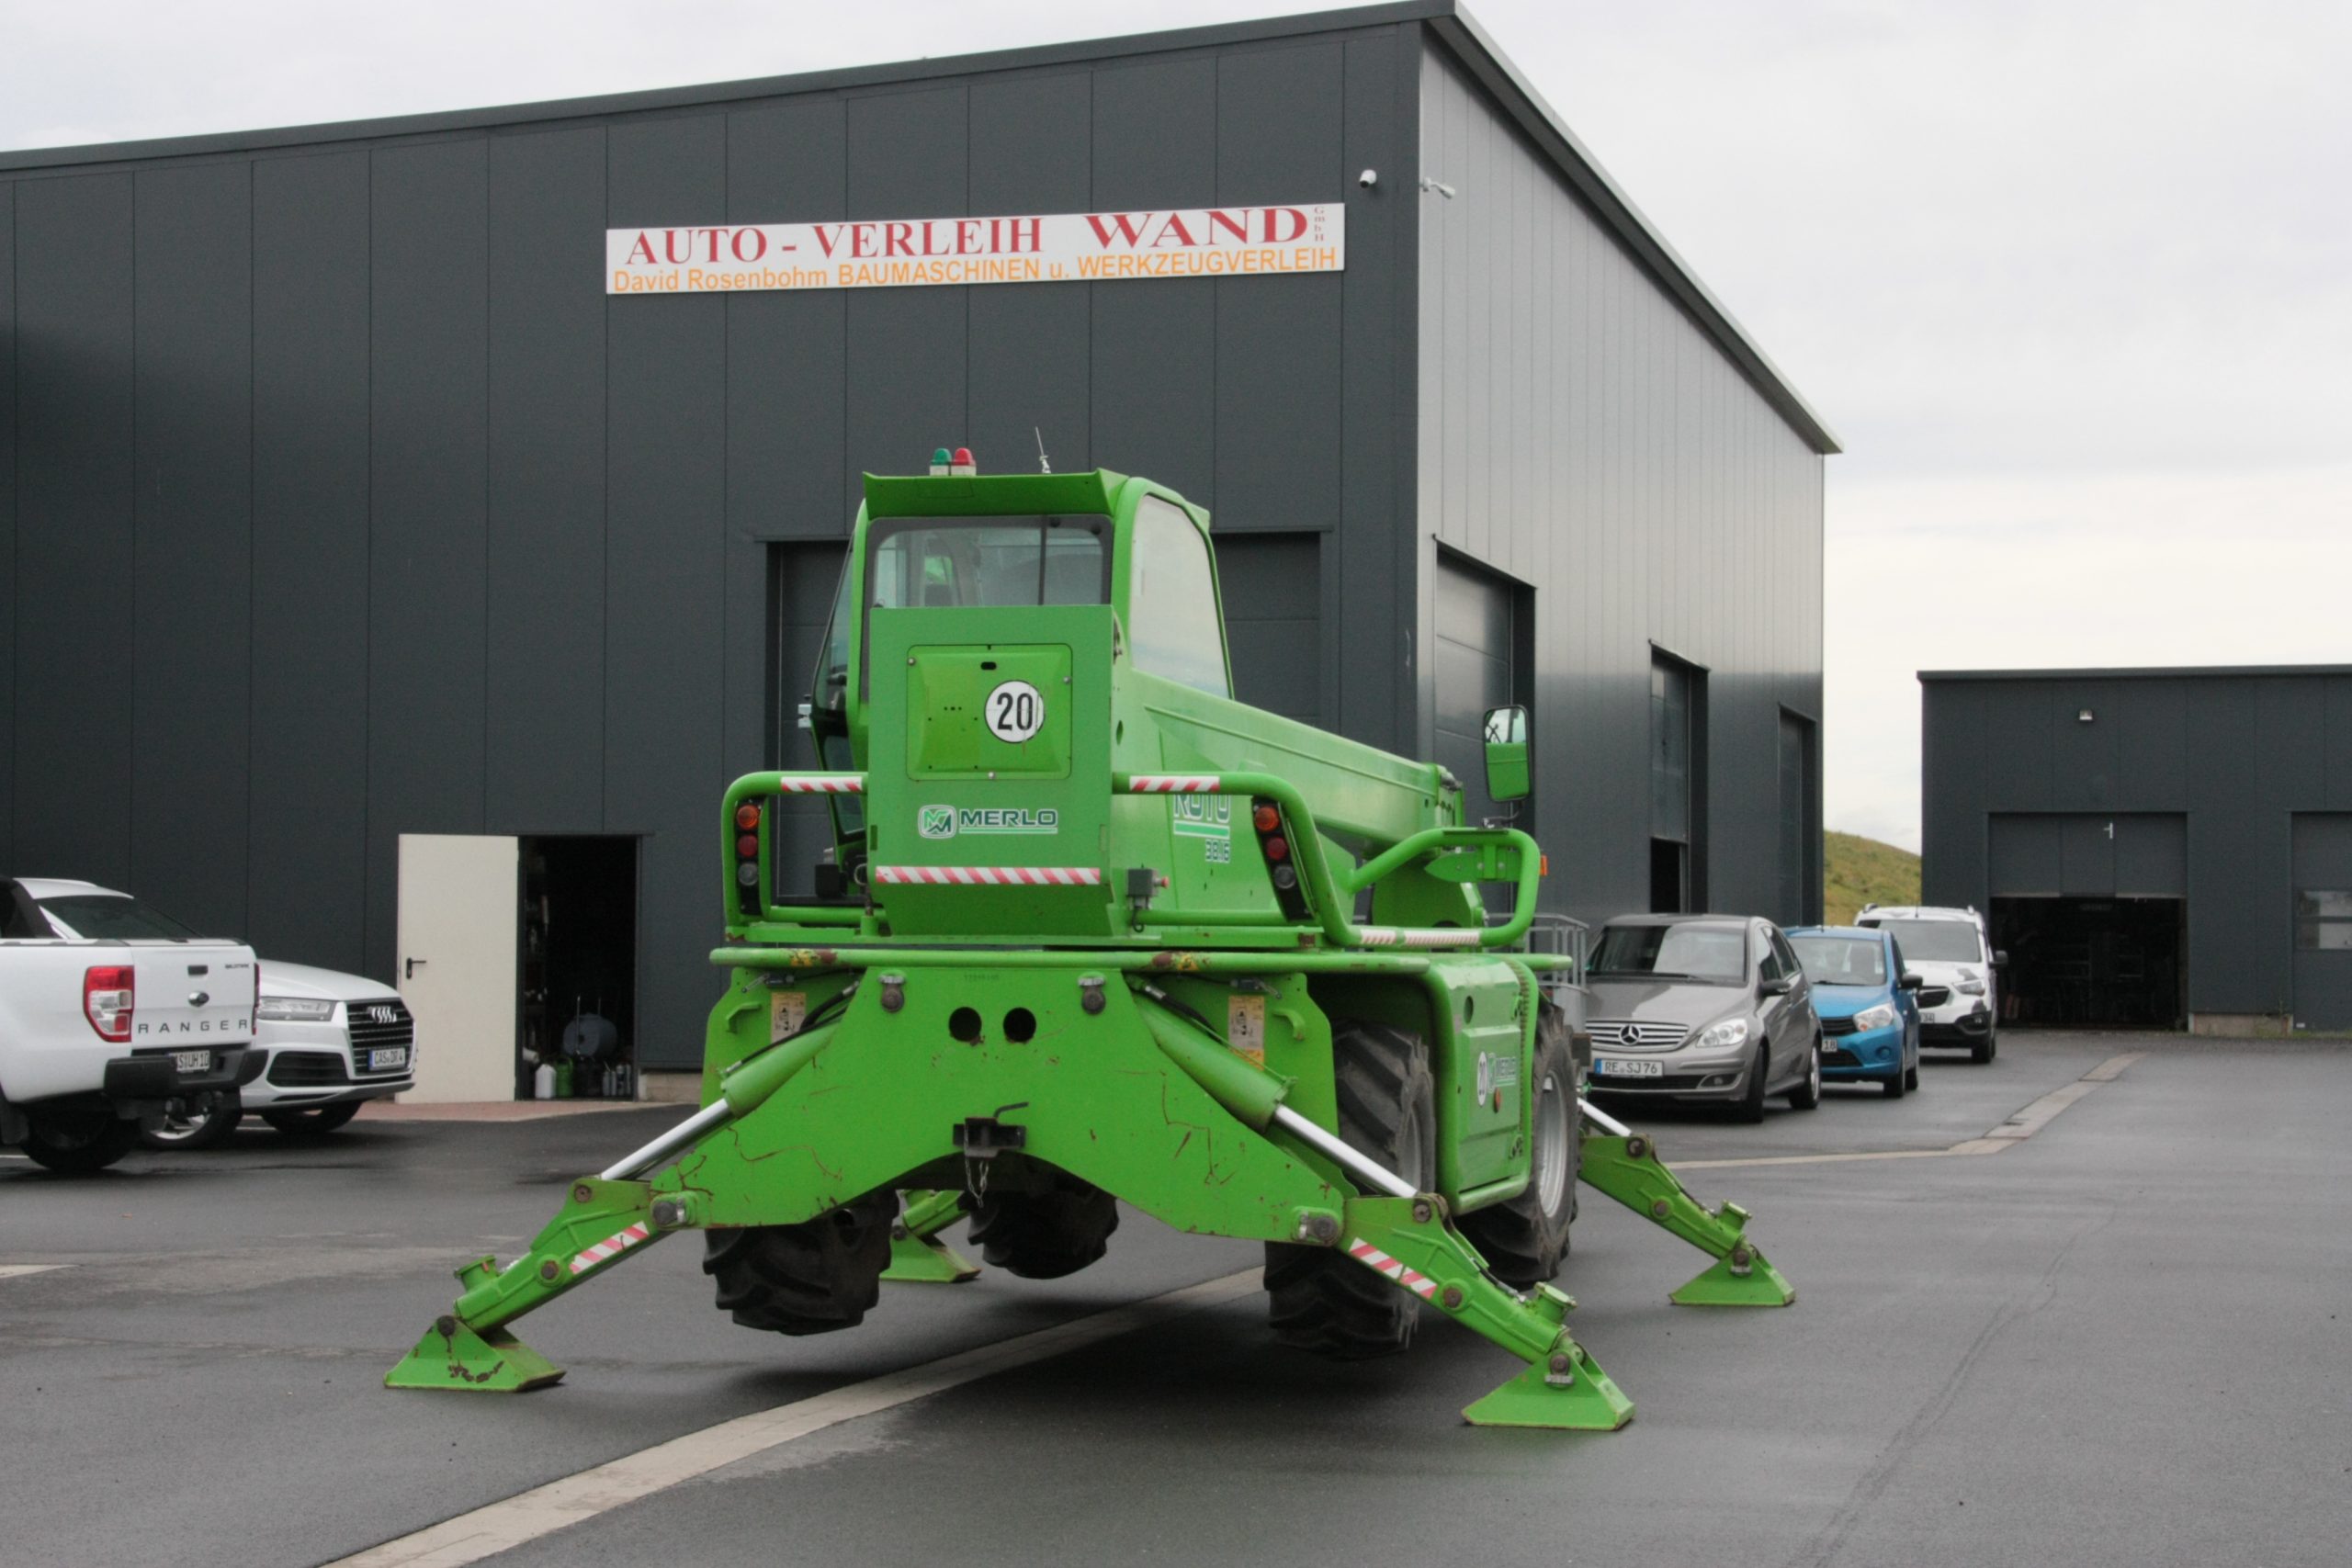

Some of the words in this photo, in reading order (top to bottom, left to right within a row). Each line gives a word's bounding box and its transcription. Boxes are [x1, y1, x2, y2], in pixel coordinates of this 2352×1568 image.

[625, 227, 768, 265] AUTO
[812, 217, 1045, 259] VERLEIH
[1084, 207, 1308, 250] WAND
[614, 269, 680, 292] David
[687, 265, 828, 290] Rosenbohm
[838, 257, 1041, 286] BAUMASCHINEN
[1049, 263, 1069, 279] u.
[1077, 246, 1336, 277] WERKZEUGVERLEIH
[996, 692, 1034, 731] 20
[959, 808, 1057, 827] MERLO
[138, 1019, 248, 1034] RANGER
